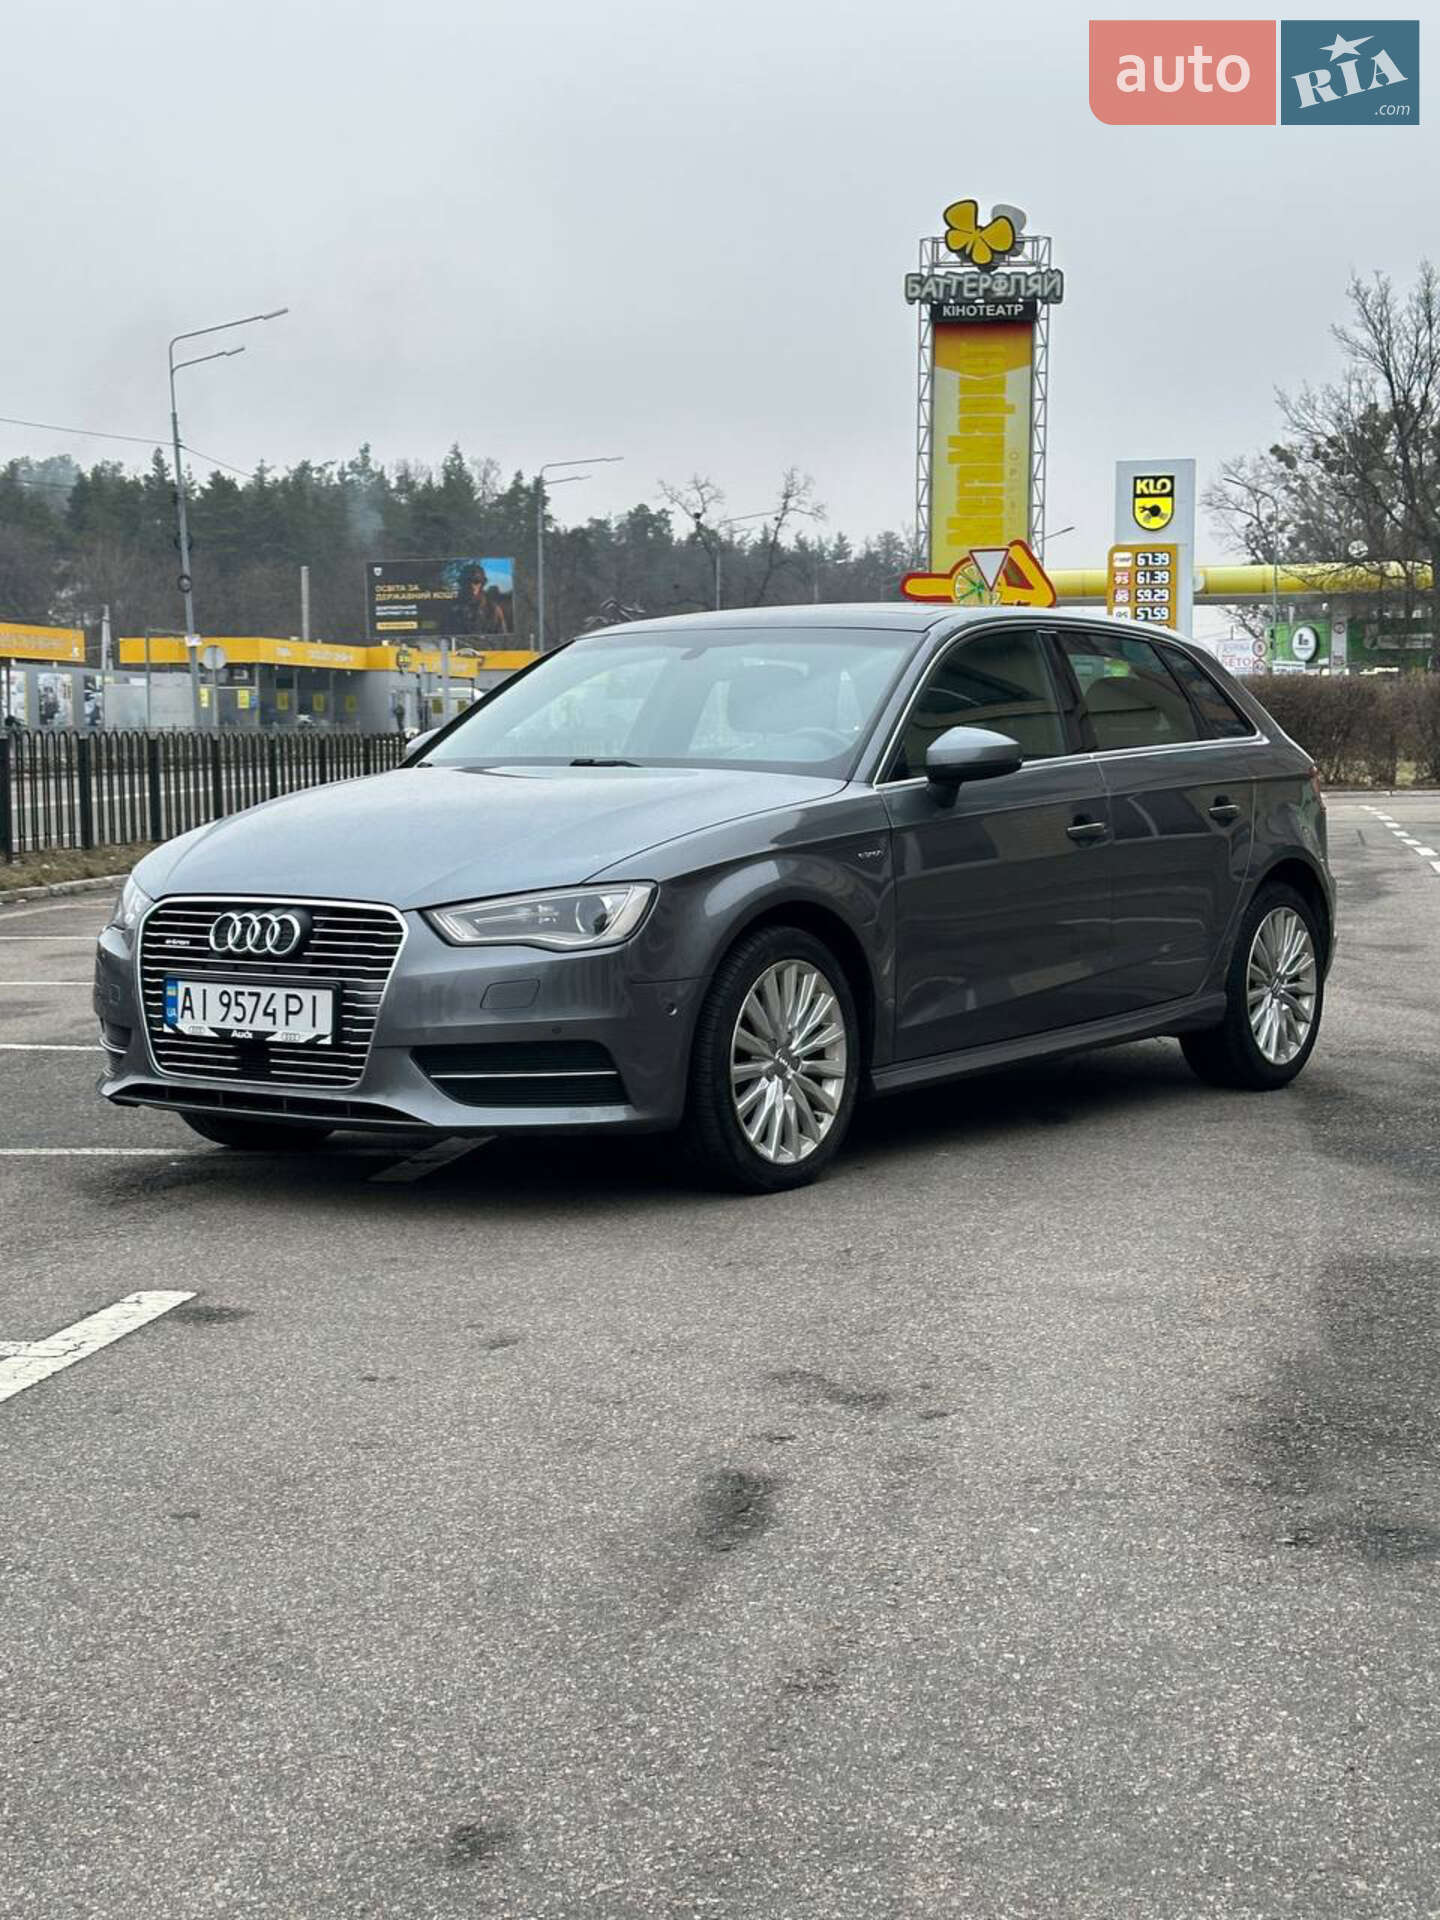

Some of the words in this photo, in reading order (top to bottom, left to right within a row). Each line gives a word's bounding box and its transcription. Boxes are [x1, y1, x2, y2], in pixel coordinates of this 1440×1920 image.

[905, 270, 1064, 303] БАТТЕРФЛЯЙ
[942, 304, 1024, 317] КІНОТЕАТР
[1135, 478, 1172, 495] KLO
[180, 986, 208, 1022] AI
[219, 989, 277, 1026] 9574
[230, 1029, 254, 1040] Audi
